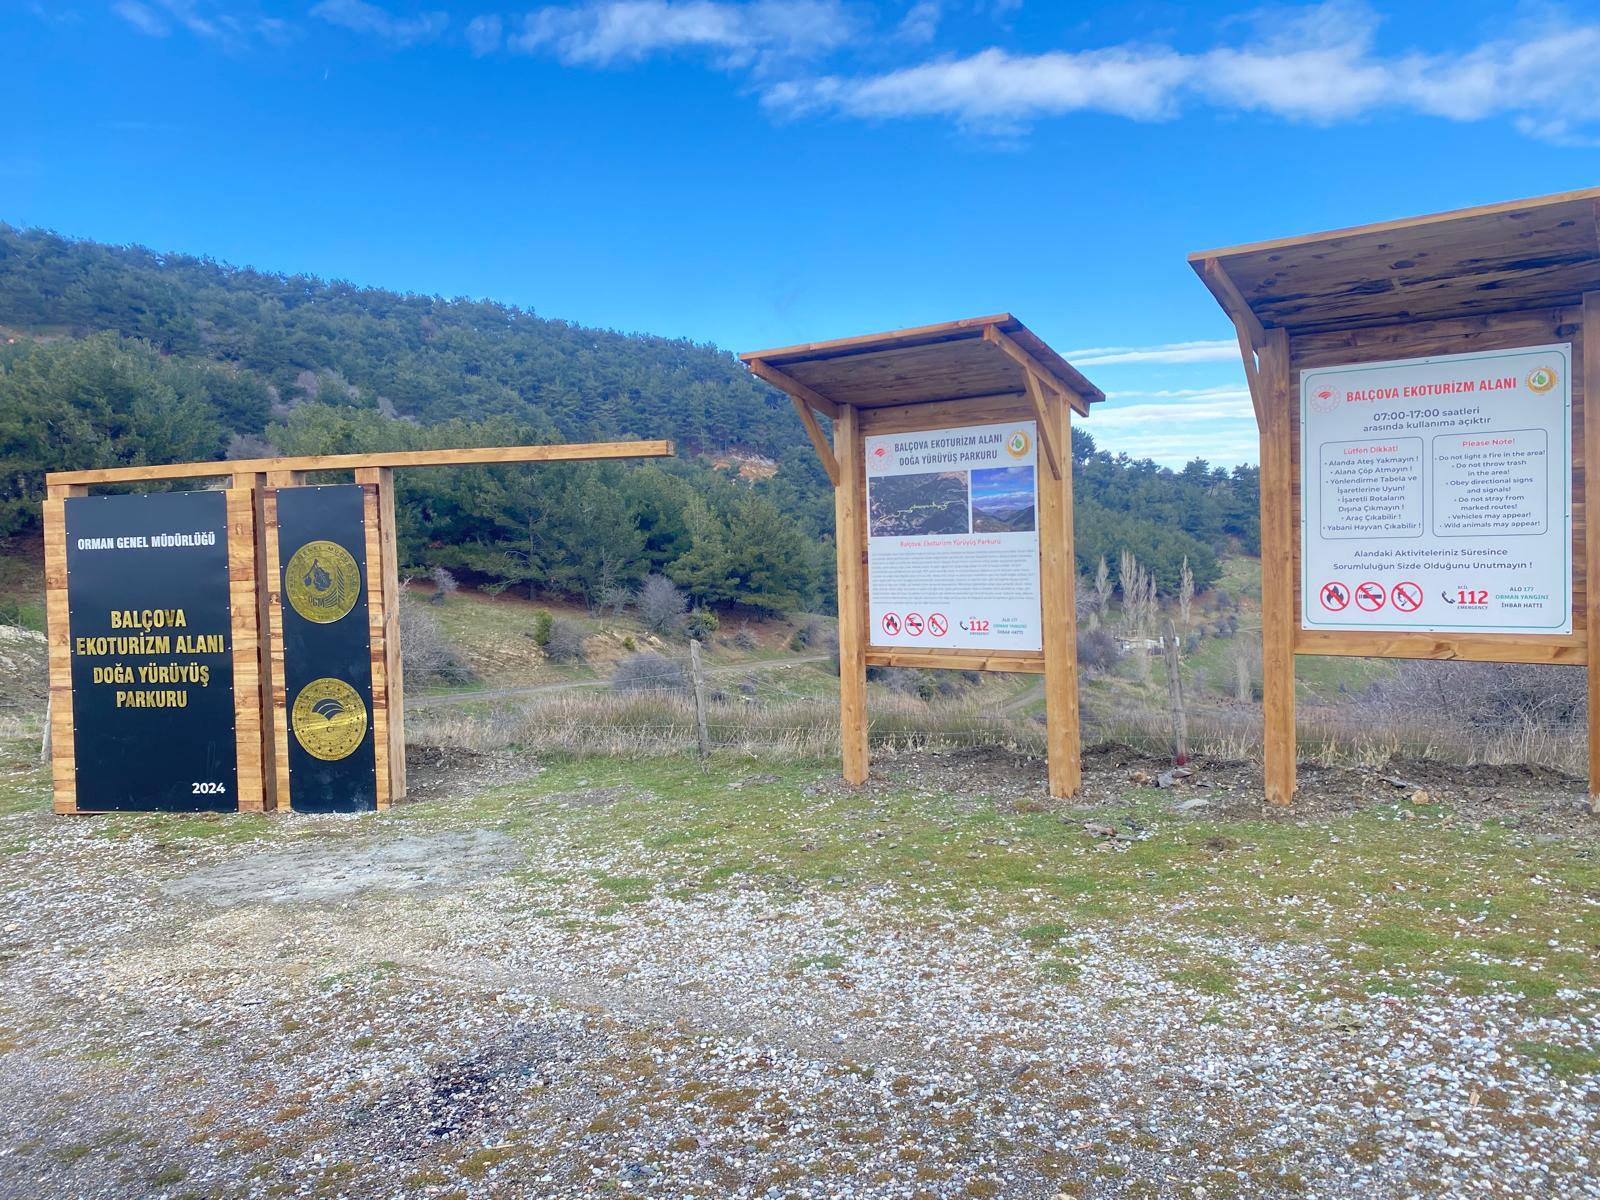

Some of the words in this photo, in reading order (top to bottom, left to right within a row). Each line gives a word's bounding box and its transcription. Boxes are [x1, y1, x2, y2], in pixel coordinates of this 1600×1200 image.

[1346, 388, 1399, 405] BALÇOVA
[1403, 380, 1474, 397] EKOTURİZM
[1479, 377, 1517, 391] ALANI
[1374, 409, 1440, 422] 07:00-17:00
[1442, 407, 1480, 417] saatleri
[1363, 421, 1404, 432] arasında
[1406, 418, 1456, 429] kullanıma
[1458, 416, 1491, 427] açıktır
[894, 440, 928, 454] BALÇOVA
[930, 436, 976, 450] EKOTURİZM
[978, 434, 1002, 444] ALANI
[899, 453, 920, 466] DOĞA
[922, 452, 958, 464] YÜRÜYÜŞ
[960, 450, 997, 462] PARKURU
[1376, 456, 1415, 464] Yakmayın
[1330, 476, 1378, 485] Yönlendirme
[1337, 485, 1380, 494] İşaretlerine
[1382, 485, 1405, 493] Uyun!
[1342, 494, 1368, 504] İşaretli
[1485, 496, 1504, 504] stray
[1363, 504, 1400, 513] Çıkmayın
[1364, 513, 1397, 521] Çıkabilir
[1384, 522, 1417, 531] Çıkabilir
[78, 537, 113, 550] ORMAN
[117, 535, 148, 549] GENEL
[151, 532, 215, 548] MÜDÜRLÜĞÜ
[1395, 548, 1459, 557] Aktiviteleriniz
[1461, 548, 1508, 556] Süresince
[1424, 561, 1470, 571] Olduğunu
[1472, 562, 1527, 570] Unutmayın
[1458, 591, 1488, 604] 112
[111, 609, 186, 632] BALÇOVA
[970, 621, 989, 631] 112
[76, 633, 171, 656] EKOTURİZM
[176, 635, 224, 653] ALANI
[93, 663, 134, 684] DOĞA
[138, 663, 209, 687] YÜRÜYÜŞ
[116, 690, 187, 708] PARKURU
[192, 783, 225, 794] 2024
